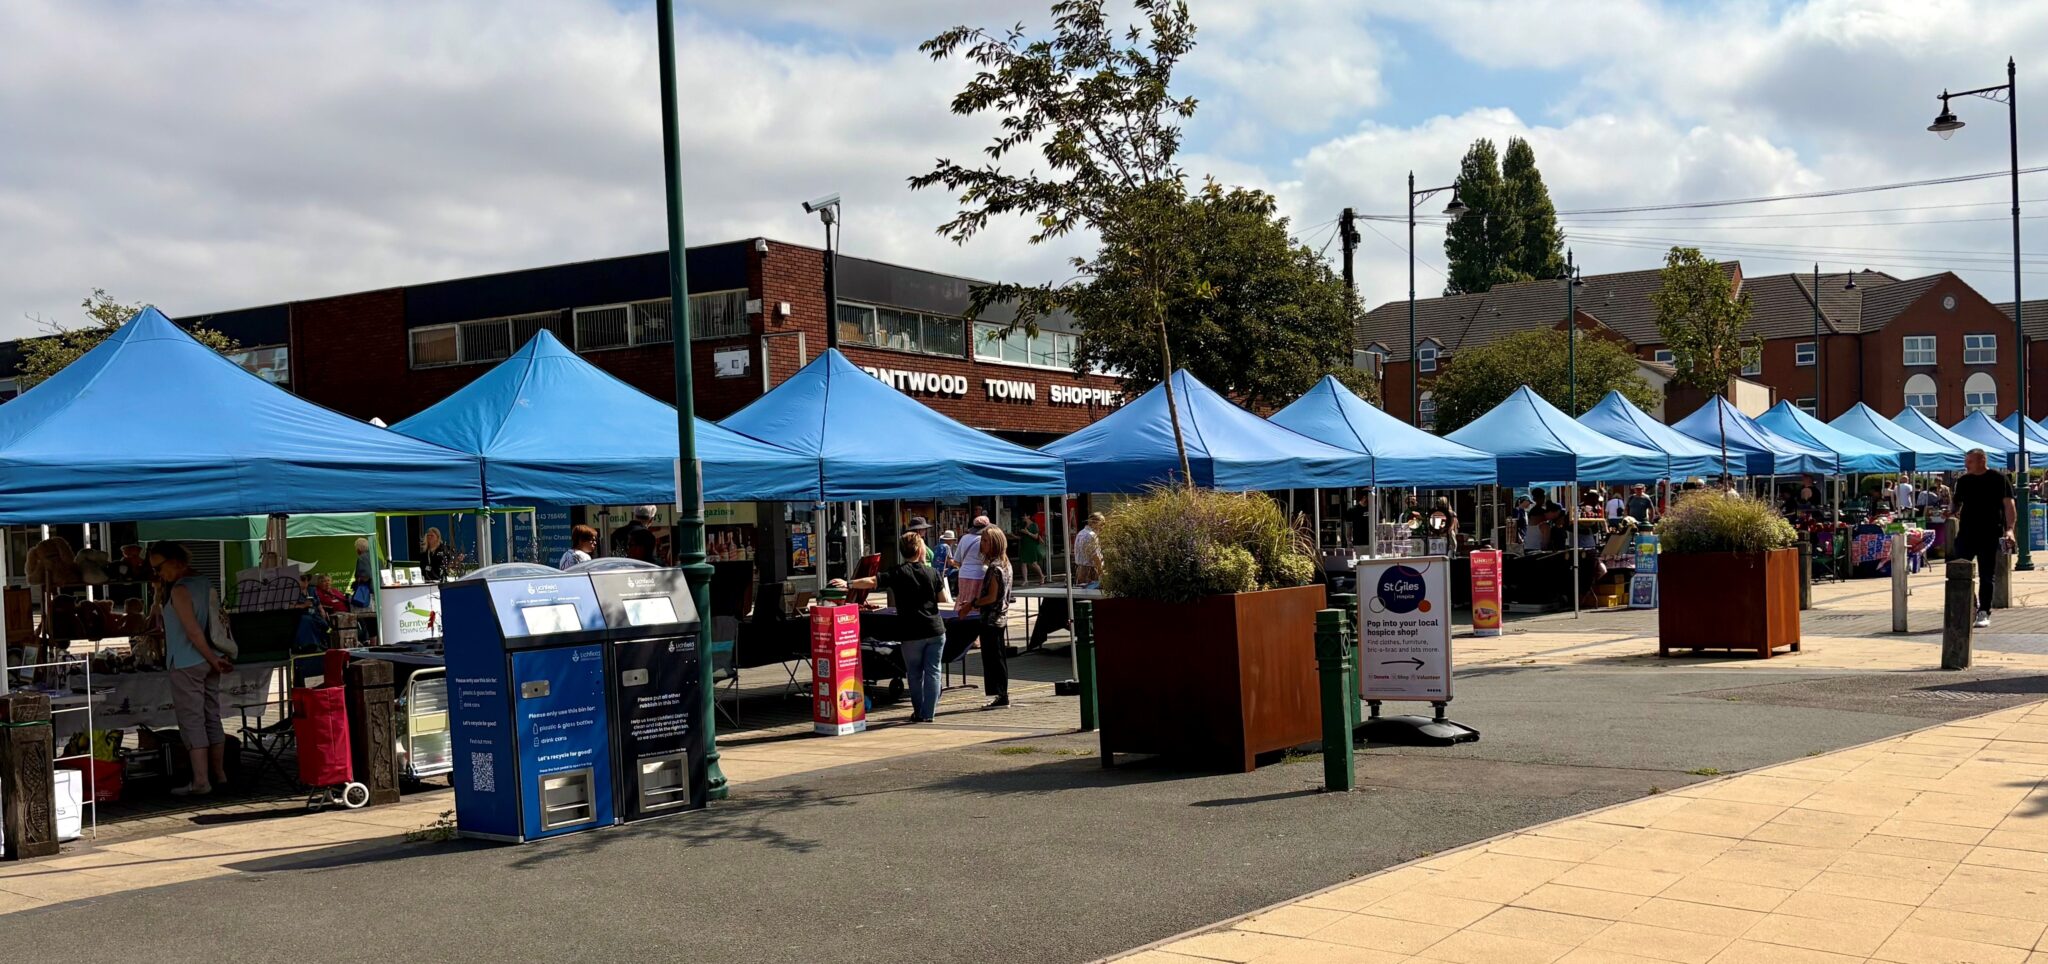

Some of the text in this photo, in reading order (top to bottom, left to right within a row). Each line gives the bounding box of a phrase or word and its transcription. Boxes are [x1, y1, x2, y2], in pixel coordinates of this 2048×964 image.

[985, 378, 1036, 400] TOWN
[593, 511, 627, 523] Nonal
[1367, 619, 1438, 628] Pop into your local
[1367, 628, 1418, 637] hospice shop!
[540, 723, 556, 732] plastic
[576, 719, 594, 727] bottles
[550, 752, 569, 760] recycle
[577, 748, 593, 757] good!
